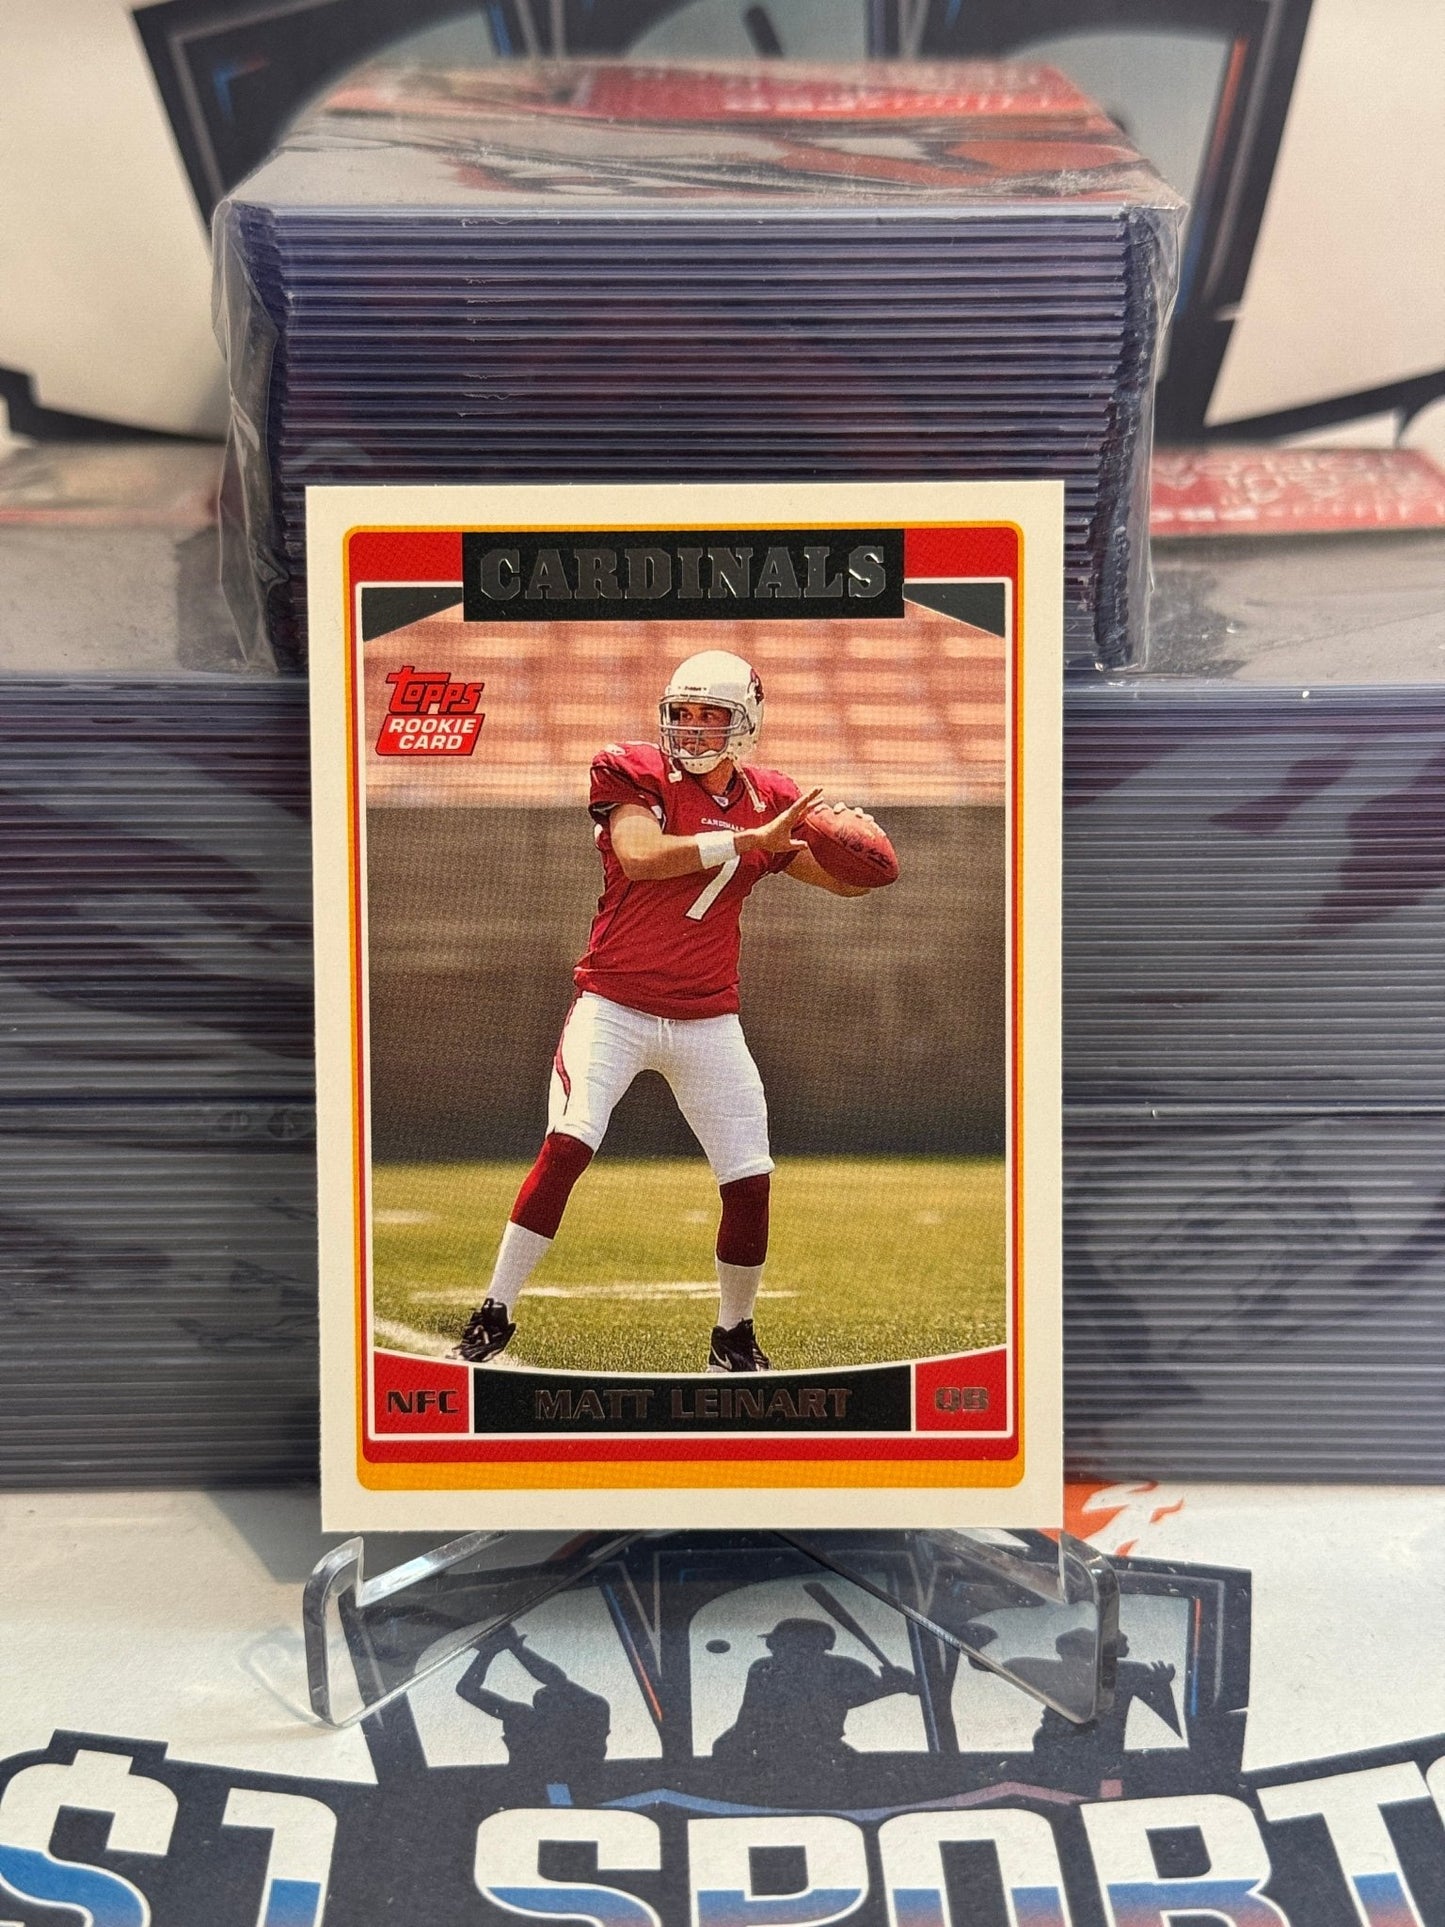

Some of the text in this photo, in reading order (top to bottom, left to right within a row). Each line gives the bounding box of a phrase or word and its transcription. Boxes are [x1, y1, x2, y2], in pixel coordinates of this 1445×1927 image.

[479, 545, 888, 602] CARDINALS
[388, 718, 476, 734] ROOKIE
[398, 734, 463, 750] CARD
[386, 1389, 461, 1414] NFC
[534, 1386, 853, 1420] MATT LEINART
[933, 1385, 990, 1413] QB
[474, 1754, 1445, 1927] SPORT
